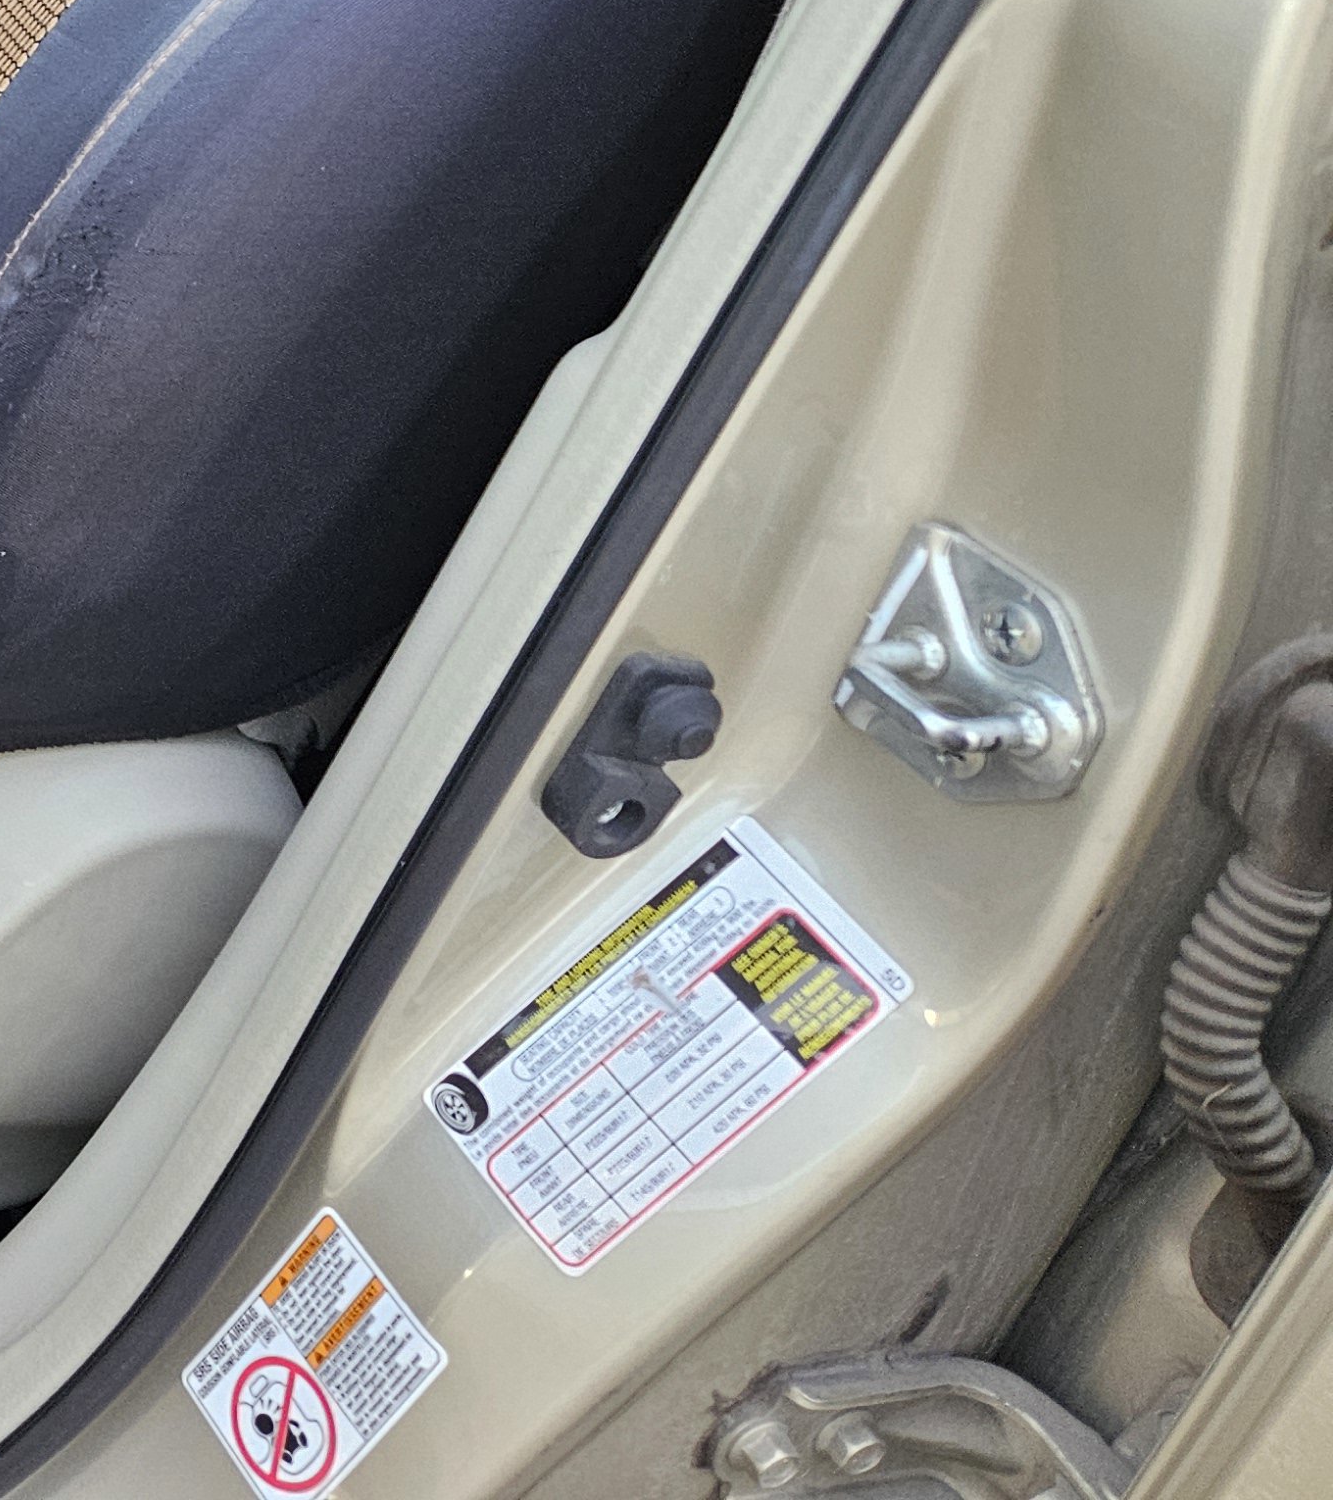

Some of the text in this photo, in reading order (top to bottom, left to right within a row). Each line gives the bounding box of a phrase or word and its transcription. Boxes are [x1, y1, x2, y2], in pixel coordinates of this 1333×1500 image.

[192, 1304, 259, 1383] SRS SIDE AIRBAG
